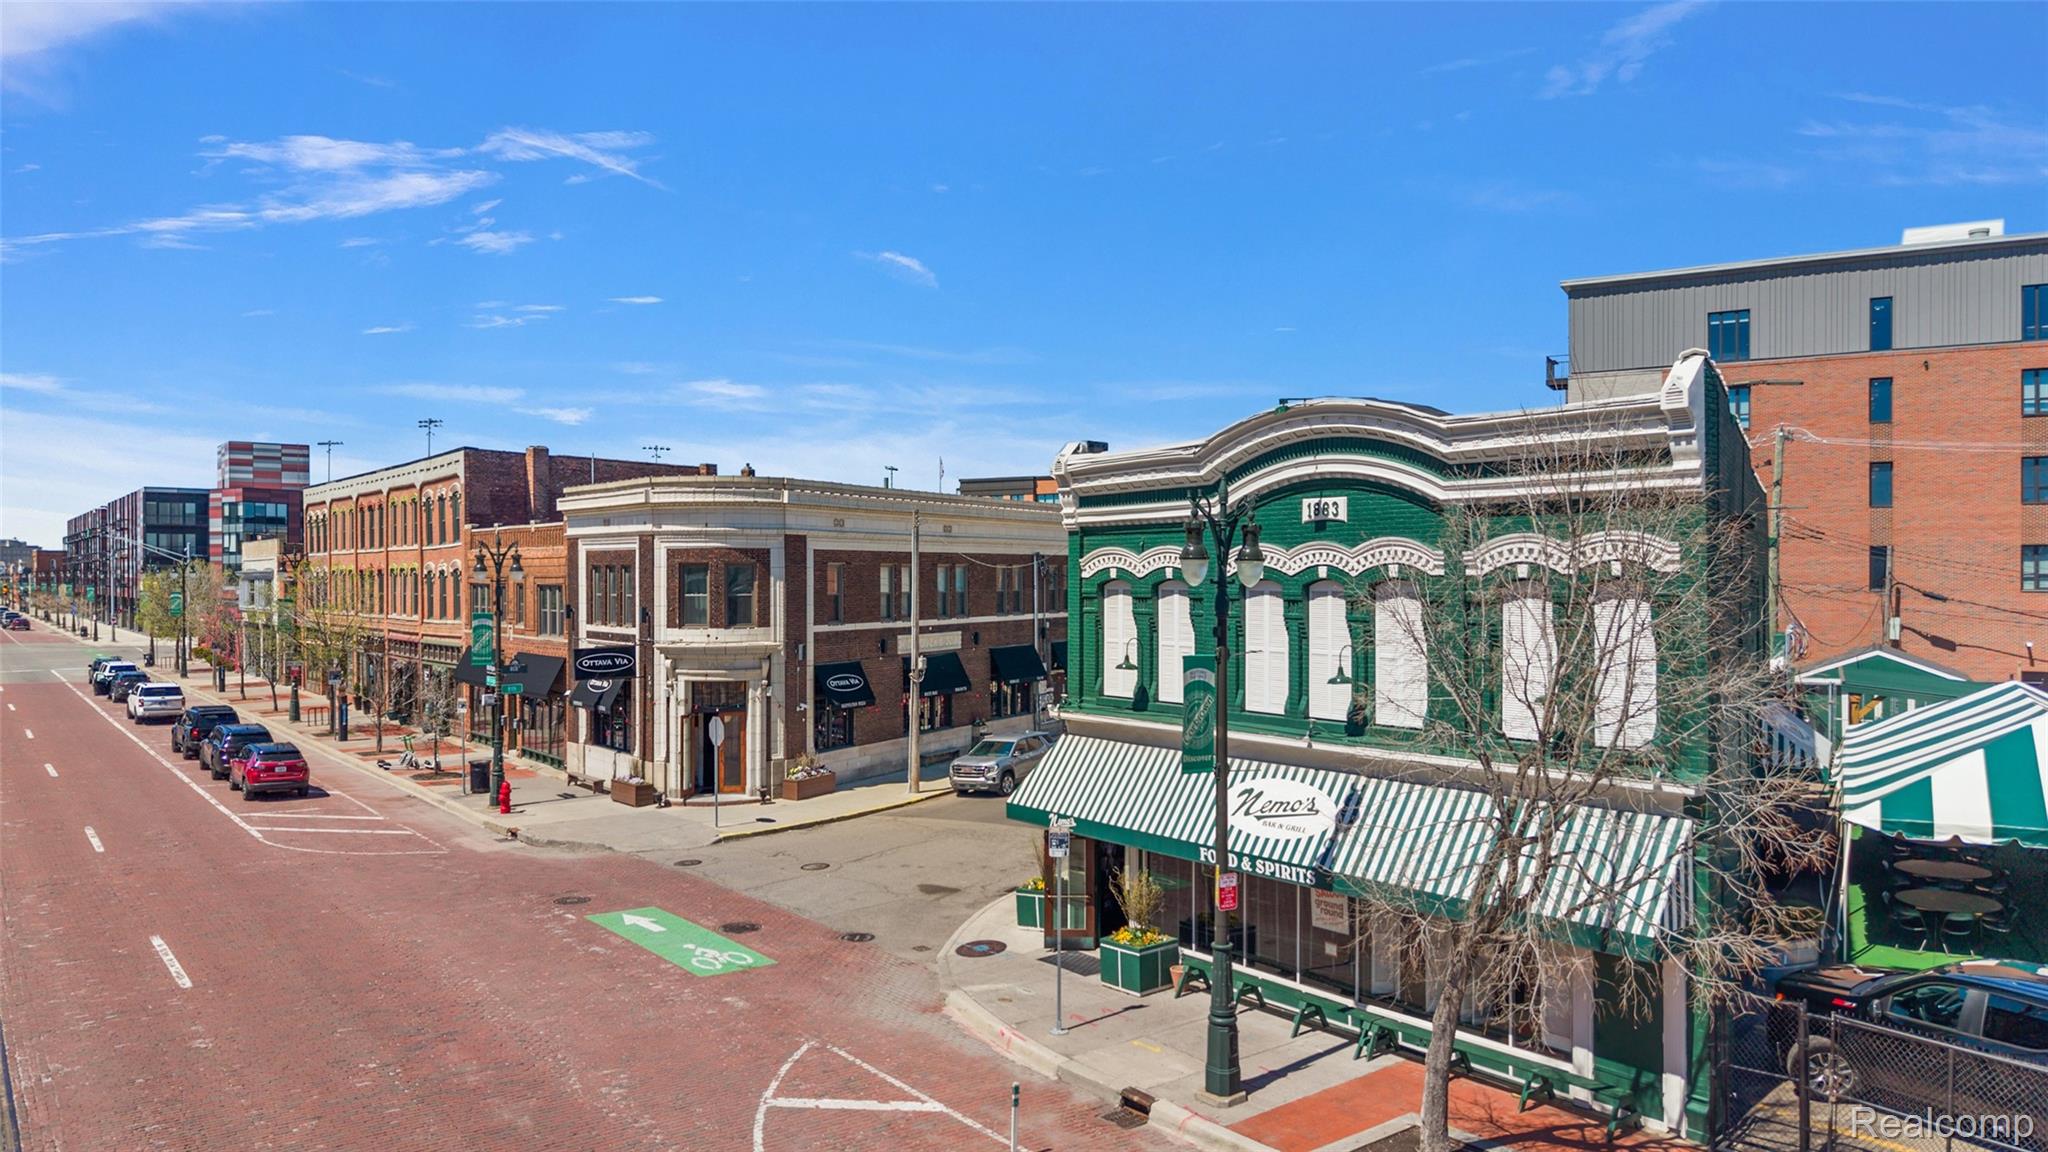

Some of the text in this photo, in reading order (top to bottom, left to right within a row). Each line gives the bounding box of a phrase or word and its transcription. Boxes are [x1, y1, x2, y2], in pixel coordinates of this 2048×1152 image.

[1307, 501, 1339, 519] 1883
[582, 657, 628, 667] OTTAVA VIA
[1231, 787, 1320, 821] Nemo's
[1262, 820, 1277, 829] BAR
[1285, 824, 1306, 834] GRILL
[1199, 846, 1238, 868] FOD
[1240, 855, 1253, 873] &
[1255, 858, 1316, 886] SPIRITS
